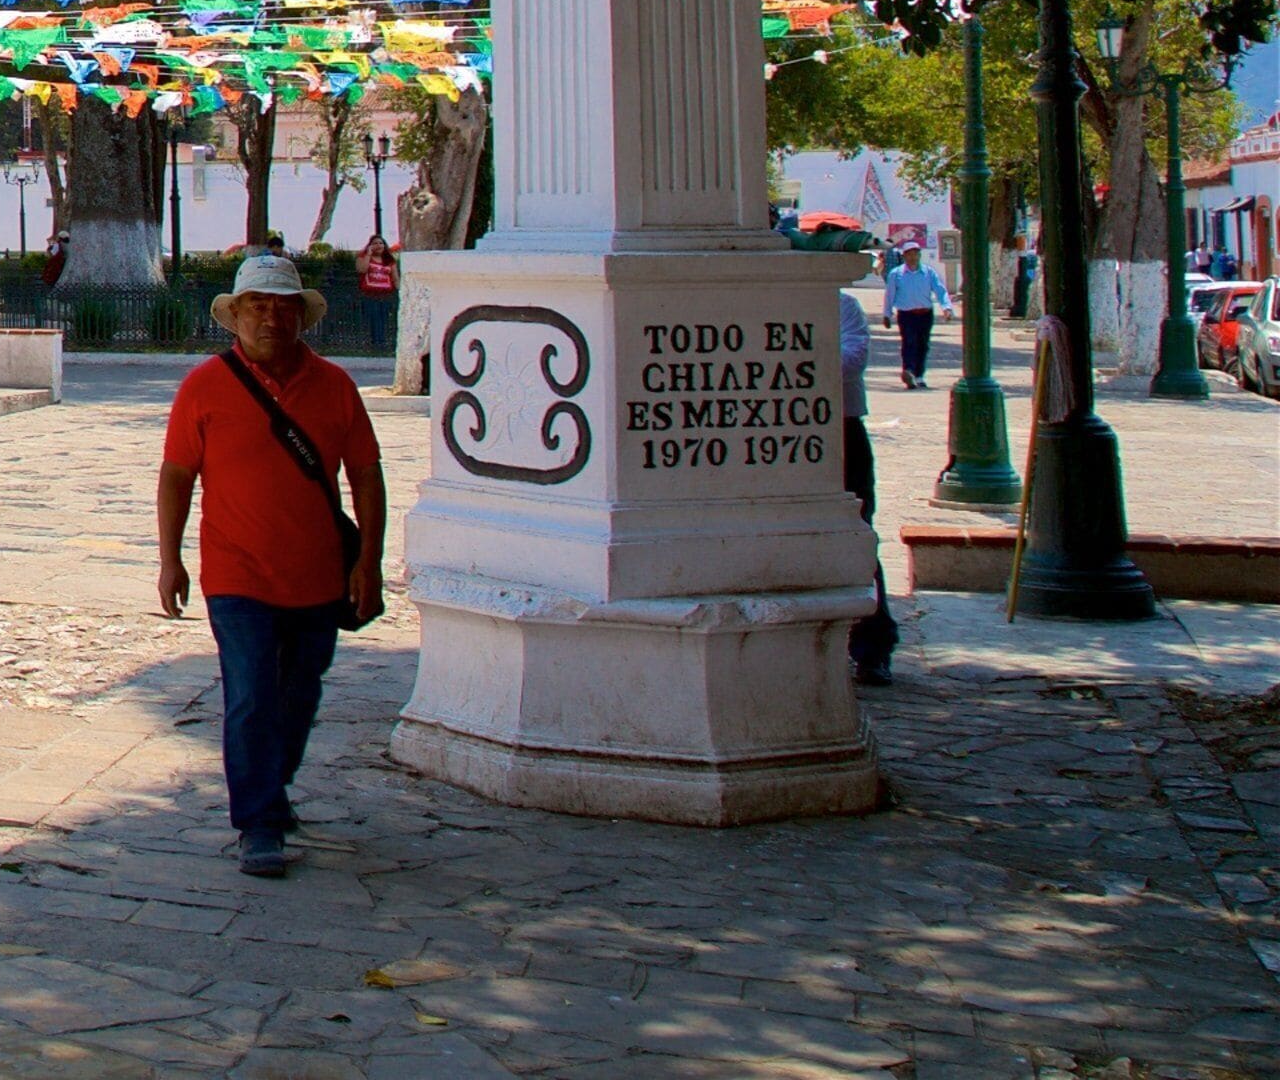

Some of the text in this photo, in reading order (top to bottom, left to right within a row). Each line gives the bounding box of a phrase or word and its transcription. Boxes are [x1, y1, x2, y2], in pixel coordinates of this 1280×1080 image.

[643, 322, 814, 354] TODO EN
[642, 361, 816, 393] CHIAPAS
[626, 396, 832, 431] ES MEXICO
[643, 434, 824, 469] 1970 1976
